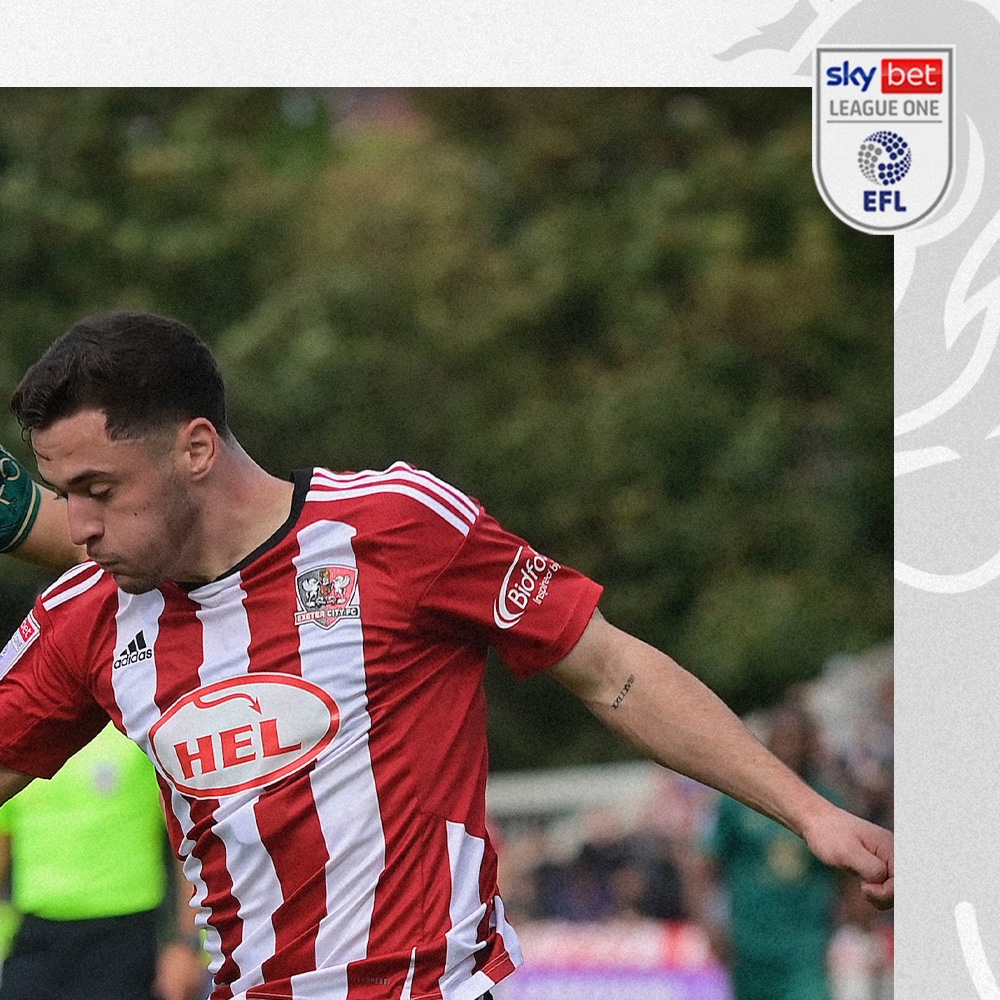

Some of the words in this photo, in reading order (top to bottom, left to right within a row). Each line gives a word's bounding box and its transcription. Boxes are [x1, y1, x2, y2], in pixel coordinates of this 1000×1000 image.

[297, 610, 325, 622] EXETER
[327, 608, 344, 617] CITY
[346, 608, 357, 616] FC
[114, 648, 153, 670] adidas
[173, 718, 302, 780] HEL
